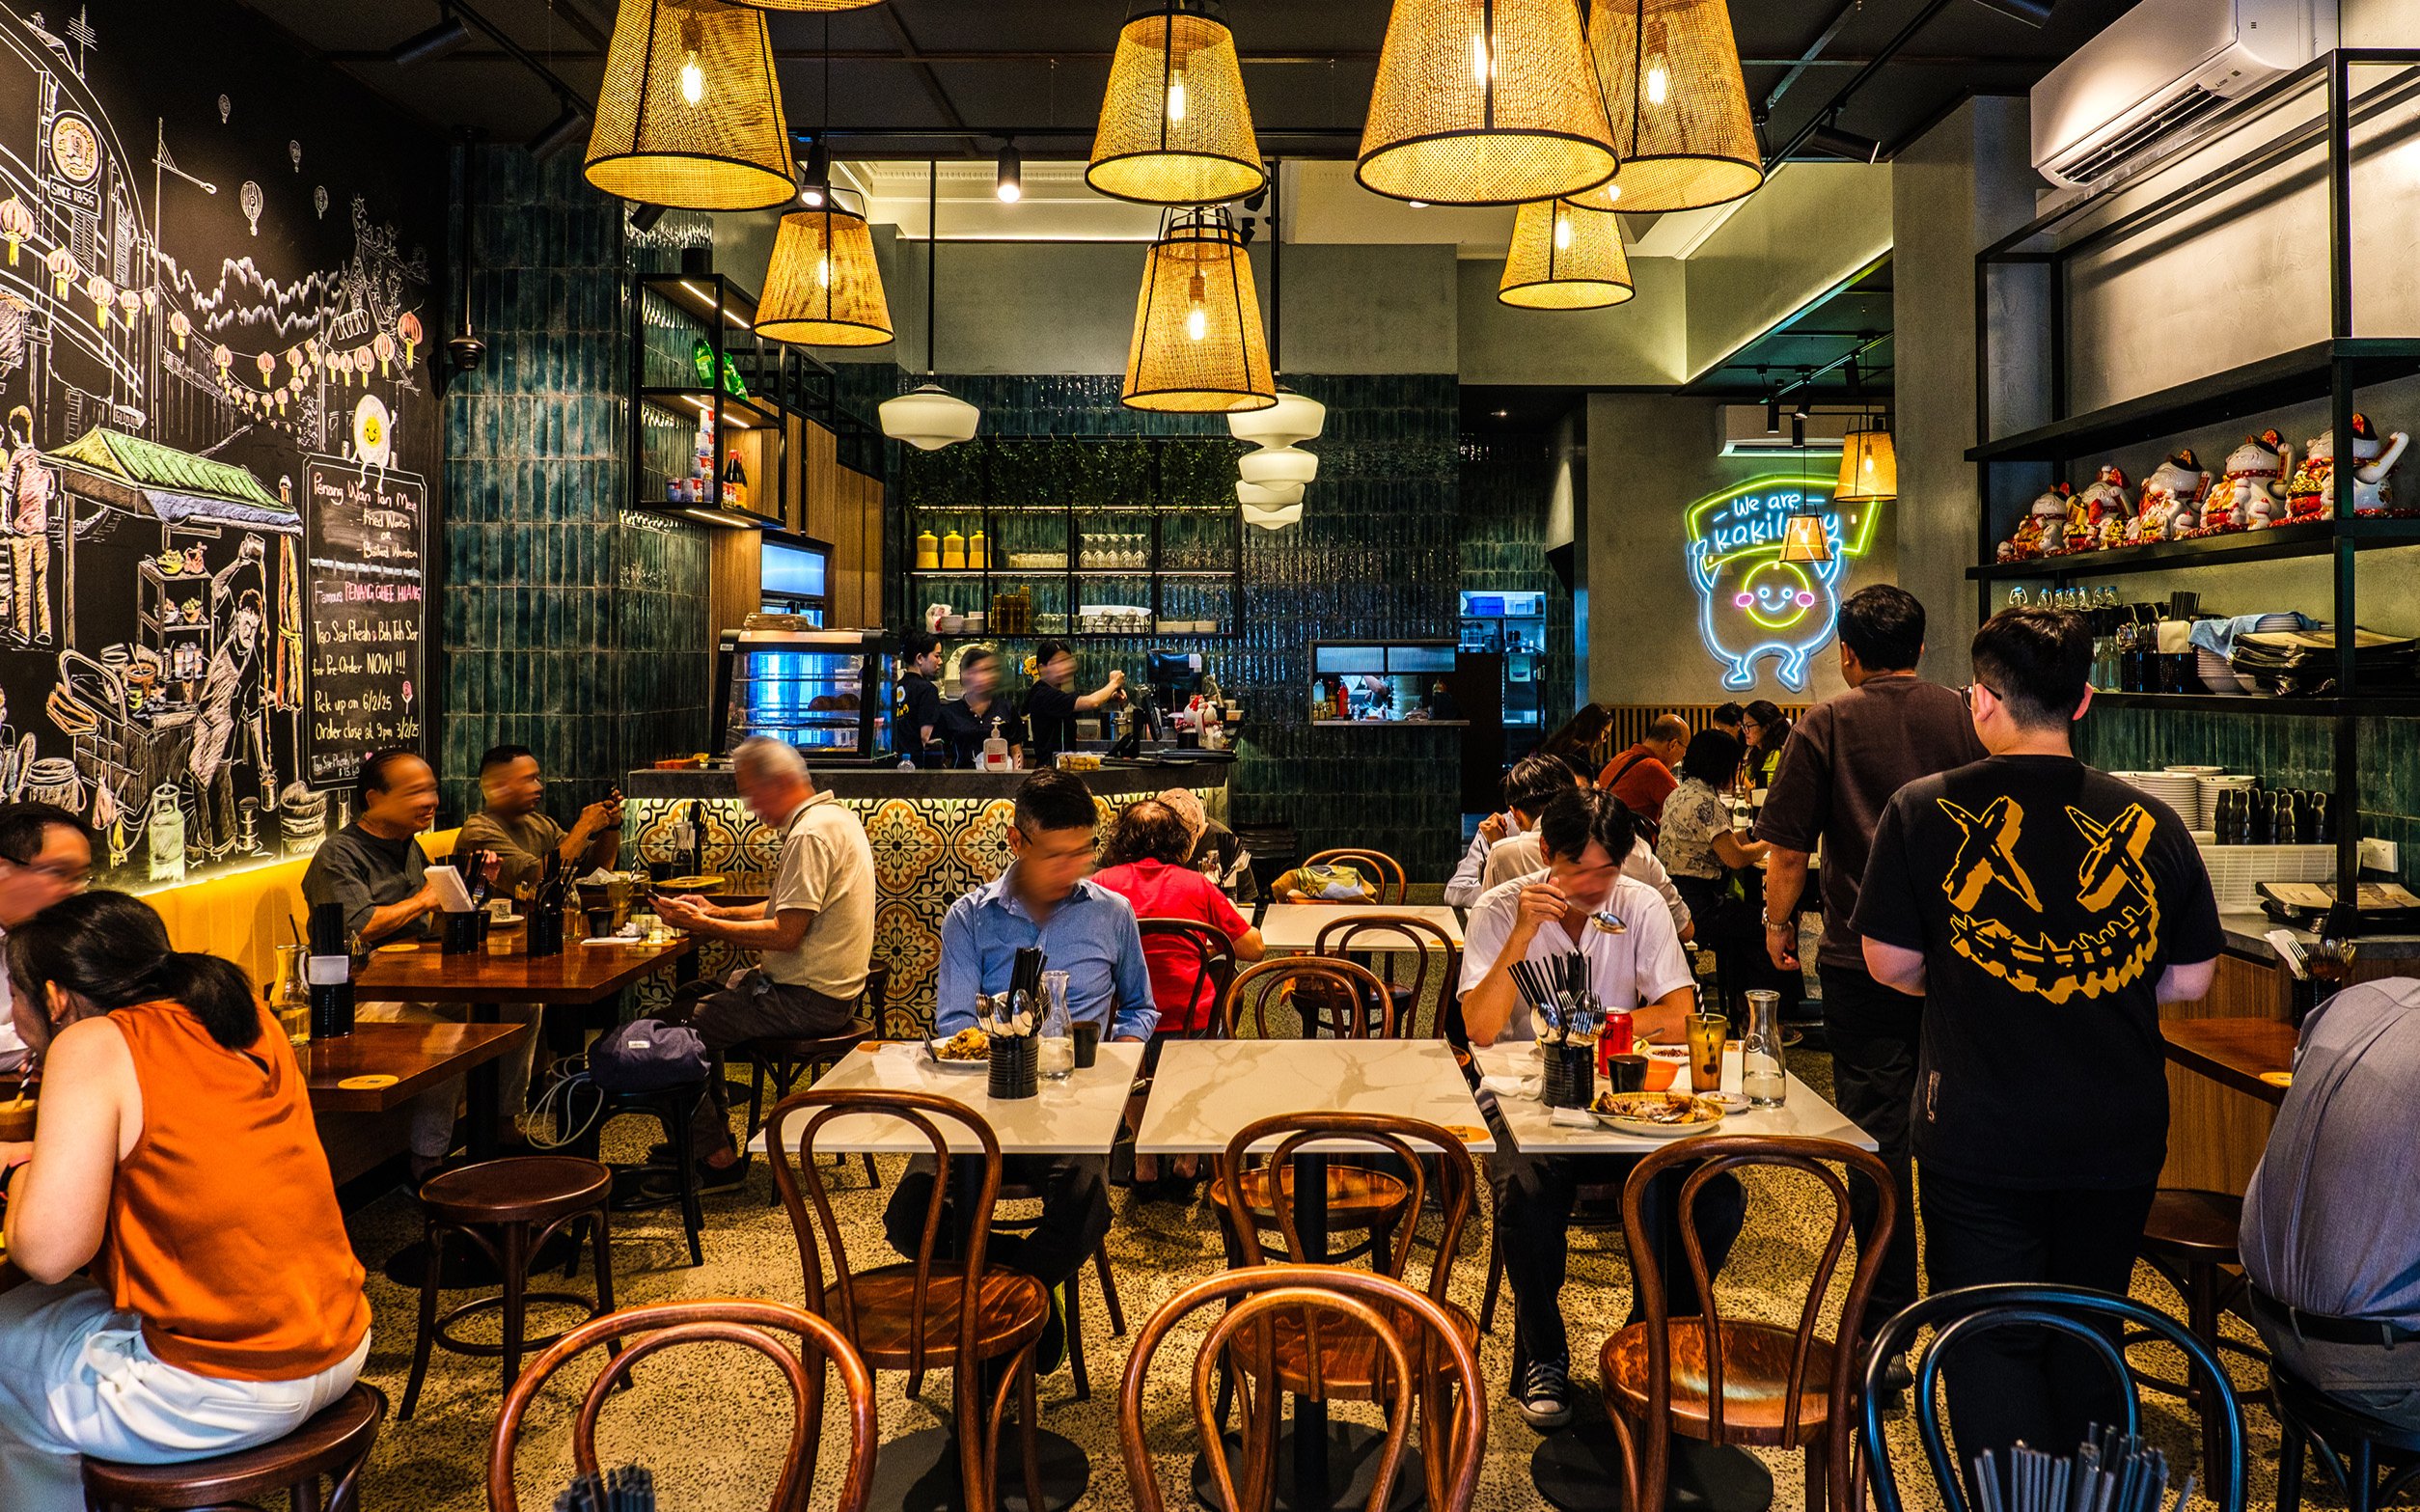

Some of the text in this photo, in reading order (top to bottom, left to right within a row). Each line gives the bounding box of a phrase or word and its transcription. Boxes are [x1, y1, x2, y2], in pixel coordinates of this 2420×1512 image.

[51, 182, 95, 206] SINCE 1856
[314, 472, 344, 506] Penang
[397, 492, 417, 511] Mee
[1733, 493, 1801, 517] We are
[314, 580, 344, 604] Famous
[344, 581, 374, 602] PENANG
[397, 584, 422, 602] HIANG
[314, 620, 331, 645] Tao
[331, 619, 347, 643] Sar
[405, 619, 419, 642] Sor
[312, 658, 324, 677] for
[367, 652, 393, 675] NOW
[315, 688, 393, 716] Pick up on 6/2/25
[316, 717, 342, 740] Order
[343, 720, 363, 741] close
[364, 722, 373, 740] at
[396, 716, 420, 740] 3/2/25
